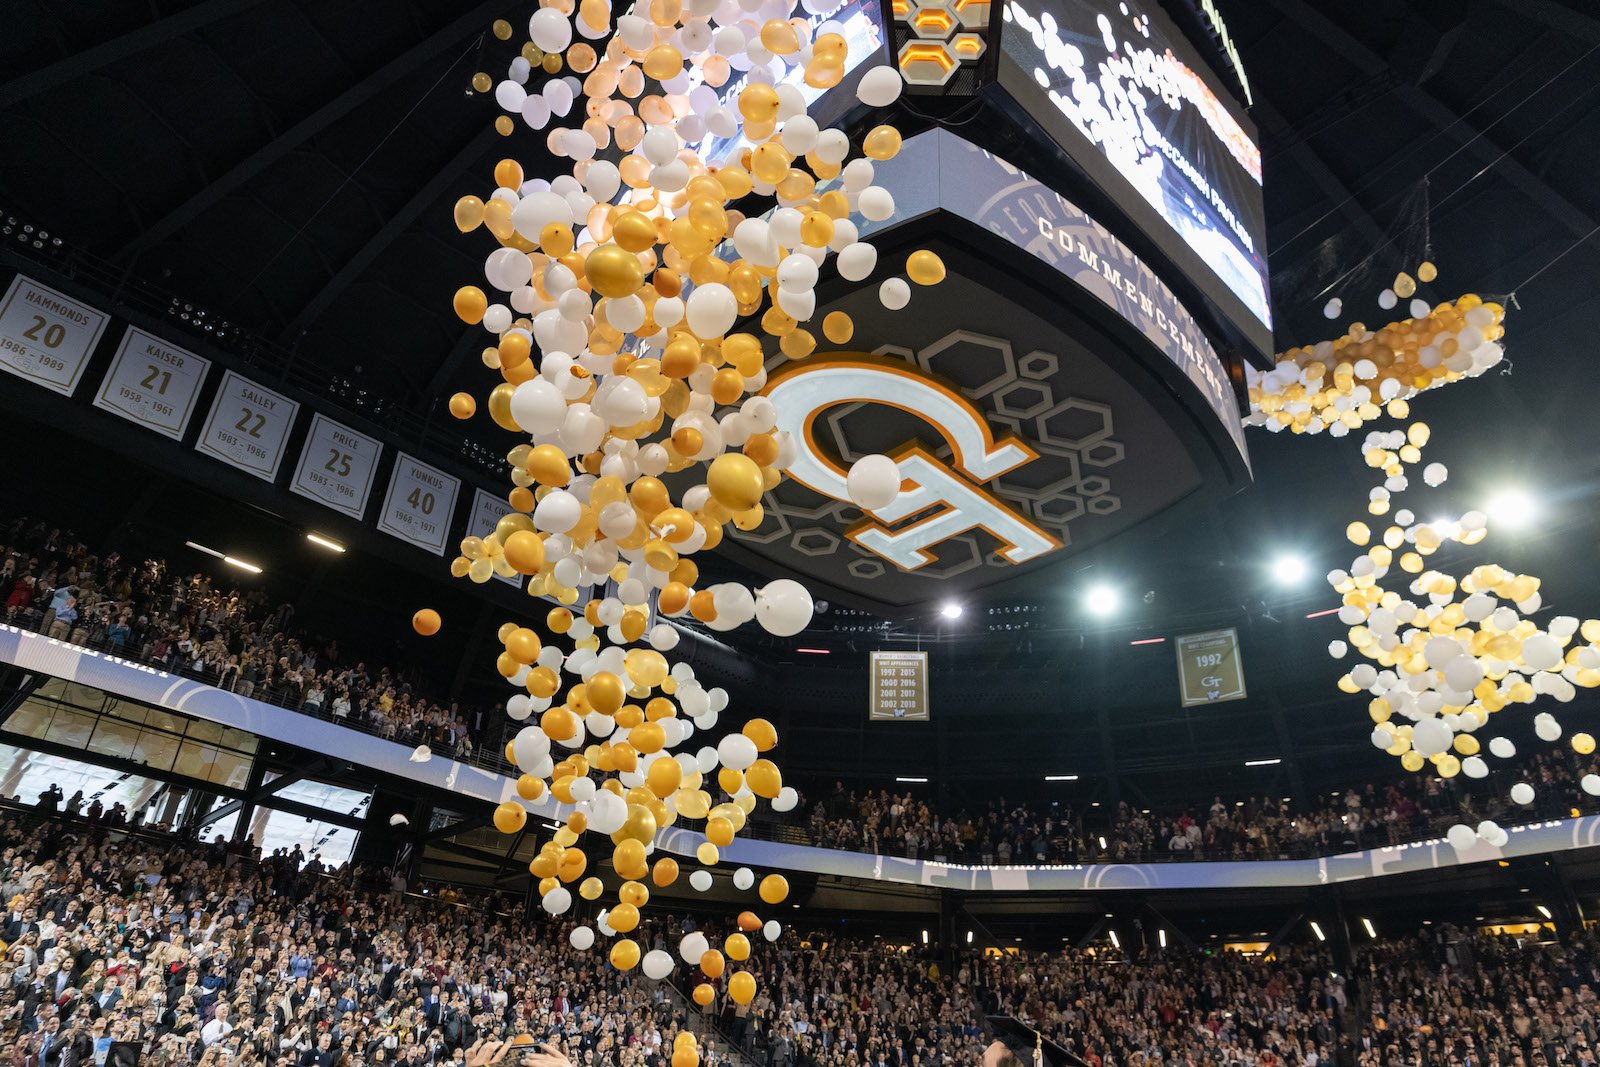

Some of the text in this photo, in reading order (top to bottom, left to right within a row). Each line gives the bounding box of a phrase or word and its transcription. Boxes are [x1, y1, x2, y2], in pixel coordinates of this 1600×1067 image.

[25, 290, 90, 326] HAMMONDS
[1038, 216, 1223, 400] COMMENCEMENT
[22, 315, 66, 348] 20
[0, 338, 26, 356] 1986
[38, 354, 64, 371] 1989
[145, 344, 185, 369] KAISER
[140, 365, 172, 395] 21
[119, 387, 142, 403] 1958
[152, 402, 173, 417] 1961
[241, 388, 276, 411] SALLEY
[235, 407, 266, 438] 22
[217, 431, 237, 446] 1983
[246, 444, 266, 459] 1986
[332, 431, 359, 450] PRICE
[324, 448, 352, 477] 25
[309, 471, 328, 487] 1983
[336, 483, 354, 498] 1986
[411, 467, 443, 489] YUNKUS
[407, 487, 435, 515] 40
[484, 501, 493, 511] AL
[395, 511, 412, 525] 1968
[420, 521, 436, 535] 1971
[881, 668, 915, 676] 1992 2015
[1196, 653, 1222, 667] 1992
[880, 679, 916, 687] 2000 2016
[880, 689, 897, 697] 2001
[880, 700, 916, 708] 2002 2018
